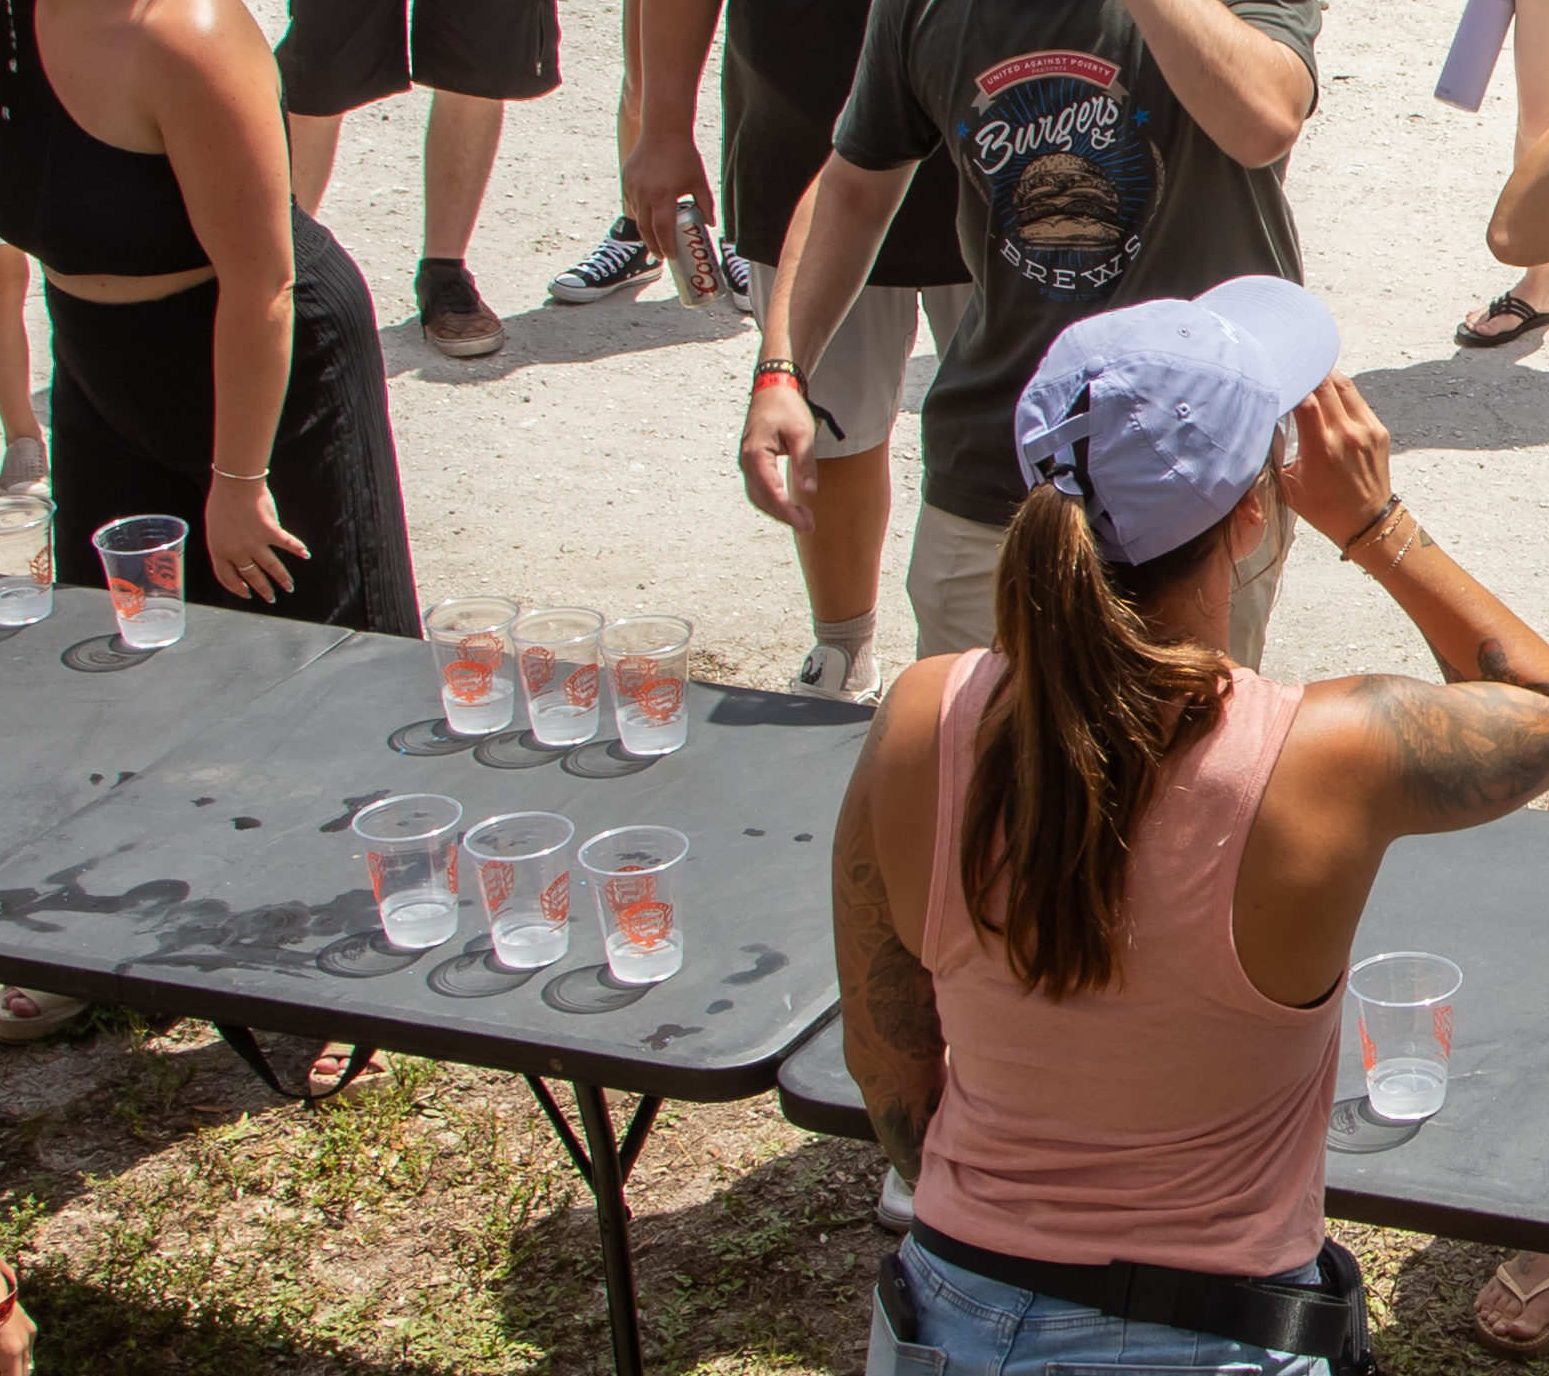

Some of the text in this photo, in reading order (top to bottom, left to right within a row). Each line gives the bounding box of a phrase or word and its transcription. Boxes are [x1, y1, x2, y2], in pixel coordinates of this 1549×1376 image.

[986, 57, 1112, 85] UNITED AGAINST POVERTY
[973, 96, 1119, 175] Burgers
[1090, 127, 1116, 150] &
[1000, 234, 1142, 290] BREWS
